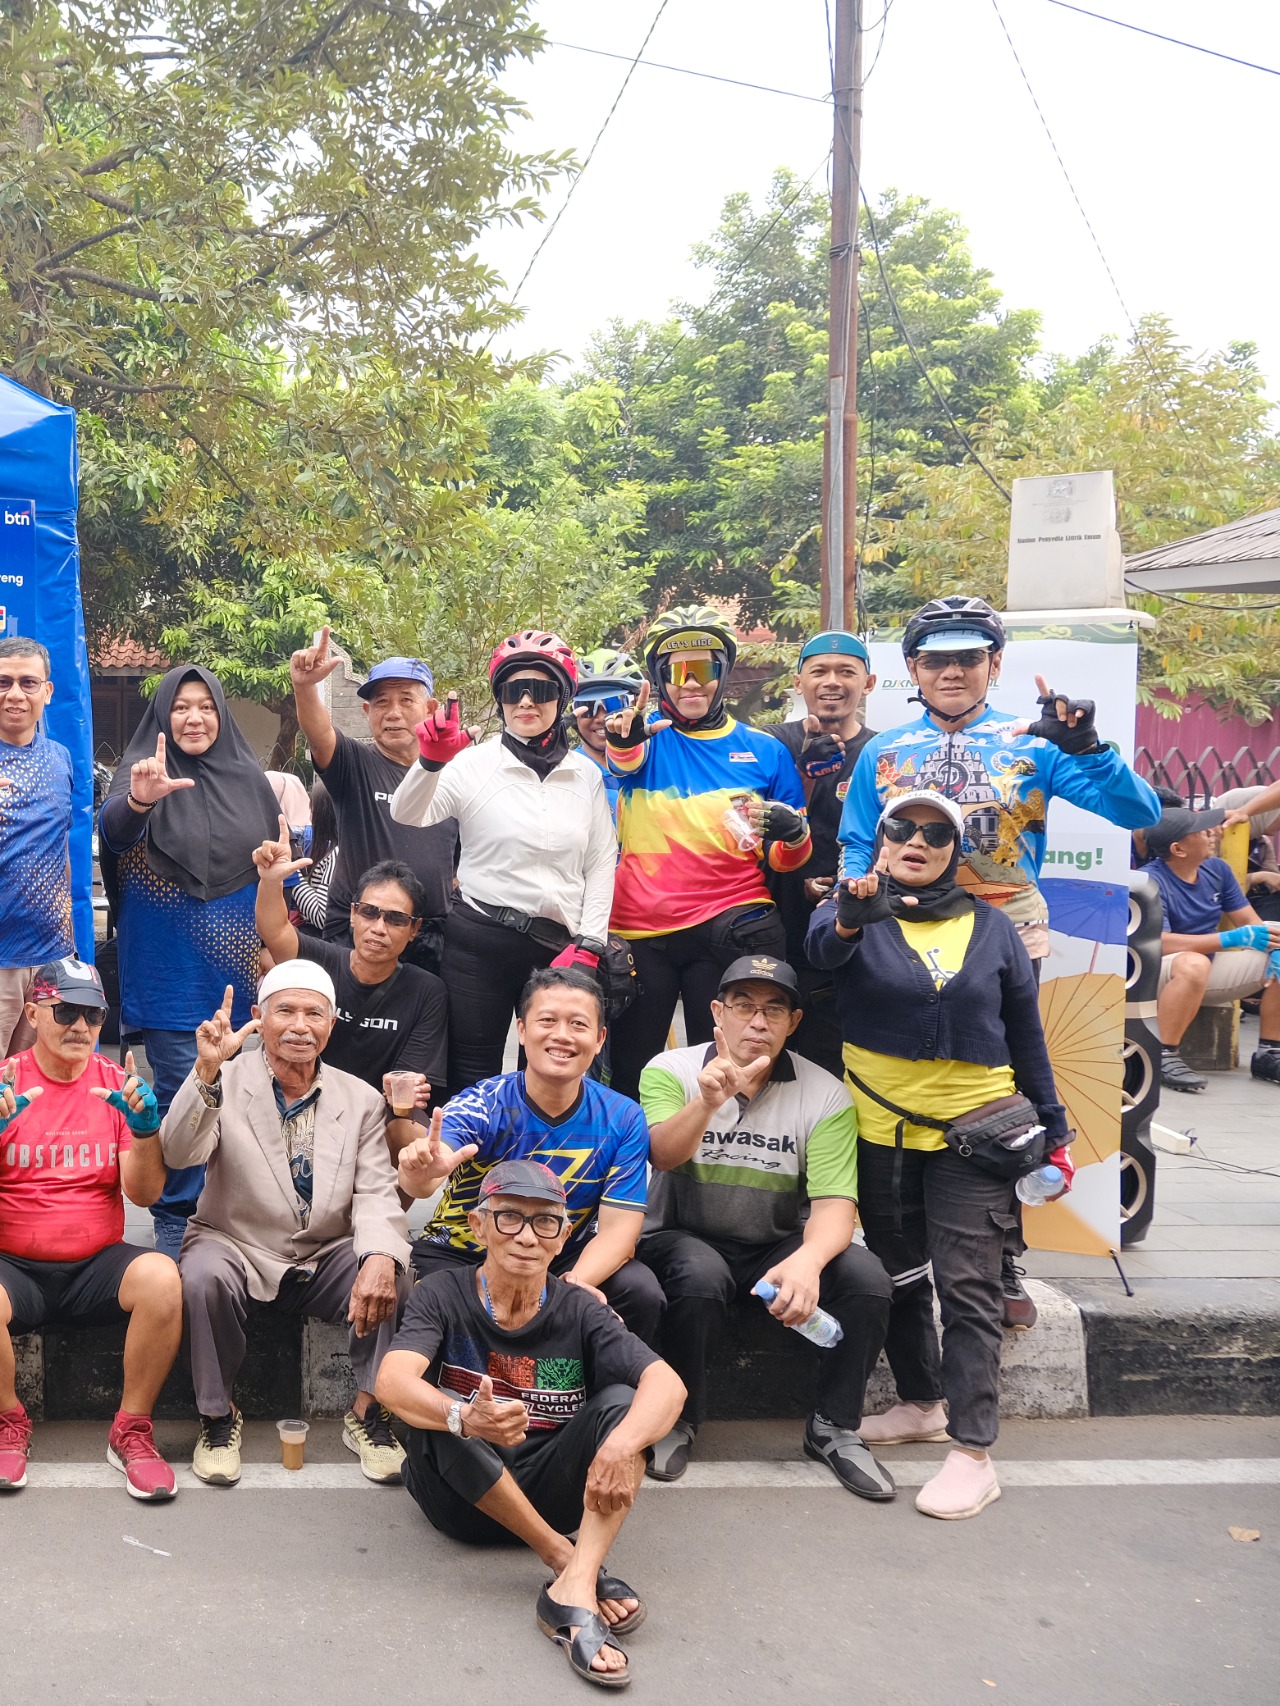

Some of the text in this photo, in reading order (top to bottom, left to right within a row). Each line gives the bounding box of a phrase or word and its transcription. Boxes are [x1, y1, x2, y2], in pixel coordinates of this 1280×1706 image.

[4, 510, 30, 525] btn
[667, 638, 713, 649] LET'S RIDE
[702, 1130, 797, 1155] awasak
[6, 1142, 118, 1168] OBSTACLE
[702, 1148, 781, 1170] Racing
[521, 1392, 585, 1403] FEDERAL
